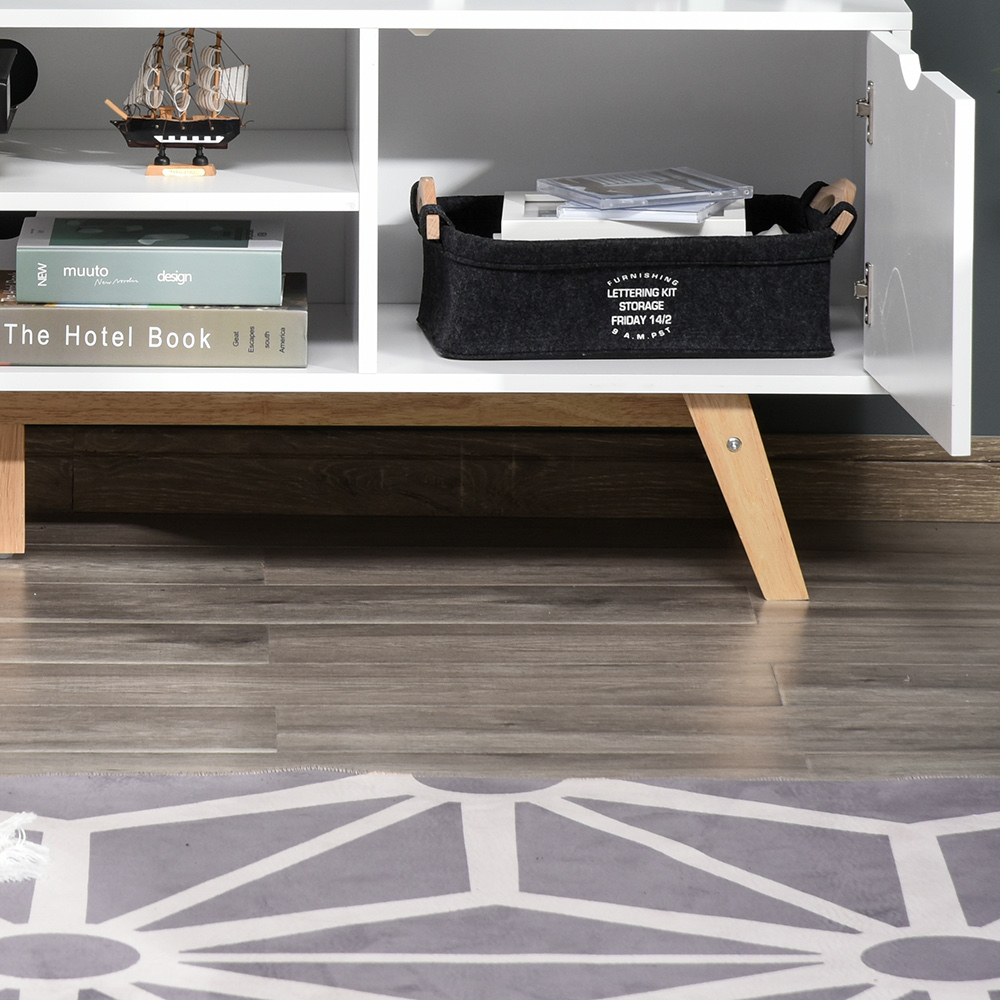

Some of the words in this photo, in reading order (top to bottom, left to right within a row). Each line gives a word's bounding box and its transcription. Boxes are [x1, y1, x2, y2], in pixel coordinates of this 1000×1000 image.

[37, 262, 48, 287] NEW
[63, 265, 109, 277] muuto
[157, 270, 192, 286] design
[607, 272, 679, 286] FURNISHING
[607, 288, 660, 298] LETTERING
[661, 288, 677, 297] KIT
[619, 301, 664, 311] STORAGE
[611, 315, 647, 326] FRIDAY
[649, 314, 672, 325] 14/2
[4, 323, 50, 345] The
[65, 325, 133, 347] Hotel
[148, 327, 212, 349] Book
